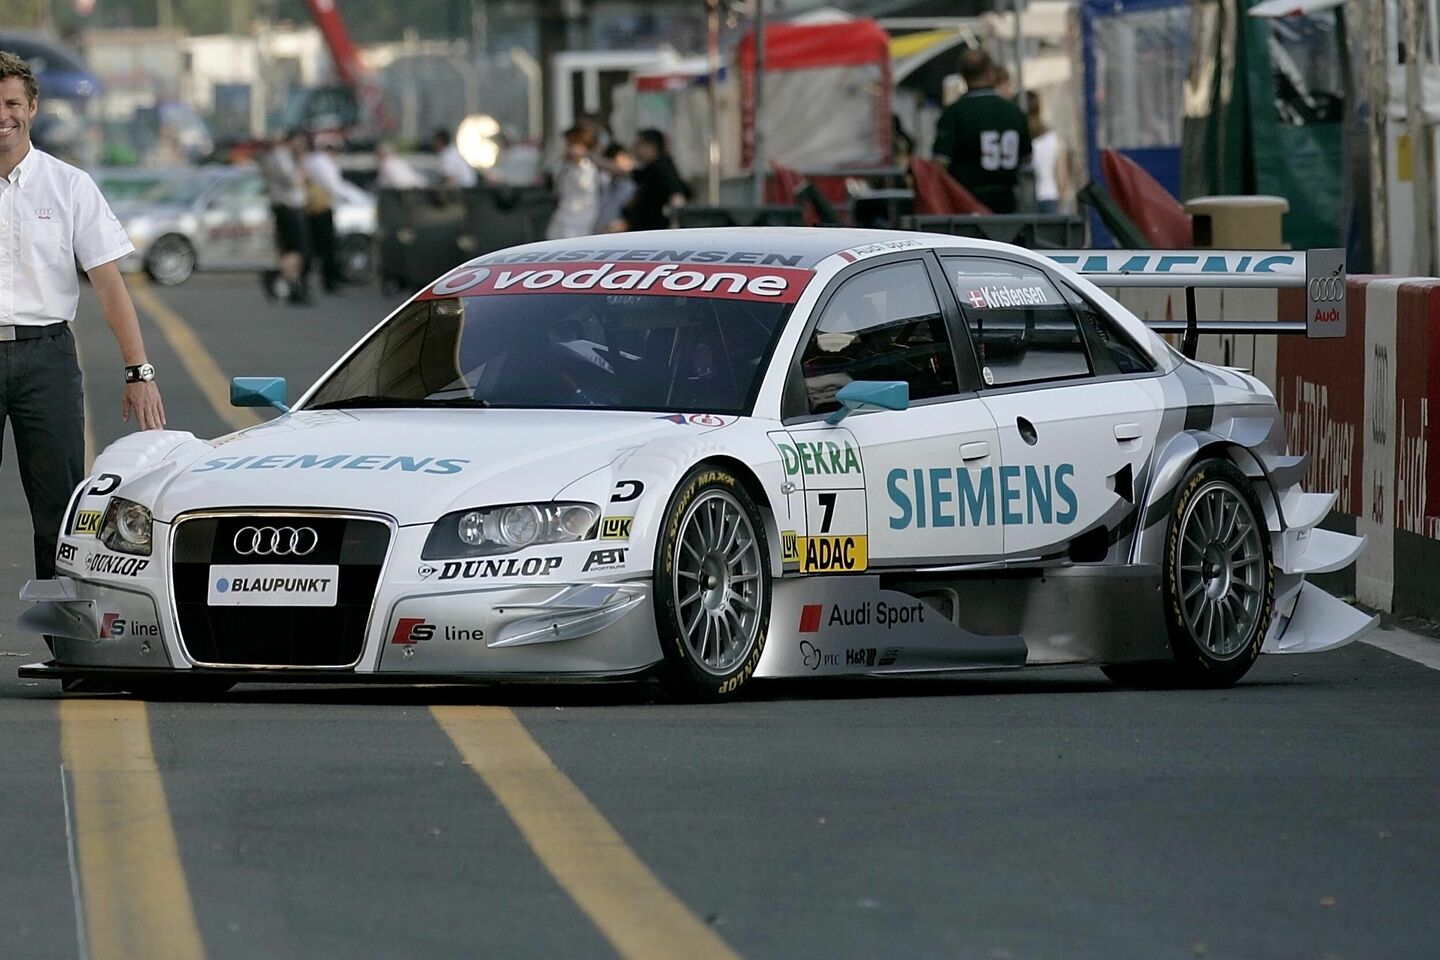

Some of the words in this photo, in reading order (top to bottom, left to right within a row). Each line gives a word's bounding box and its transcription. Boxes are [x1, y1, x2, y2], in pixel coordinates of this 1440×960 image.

[980, 131, 1019, 171] 59
[479, 248, 803, 266] KRISTENSEN
[493, 263, 788, 297] vodafone
[980, 285, 1047, 308] Kristensen
[1314, 308, 1340, 322] Audi
[190, 454, 472, 475] SIEMENS
[778, 440, 861, 476] DEKRA
[1396, 397, 1428, 536] Audi
[886, 464, 1078, 530] SIEMENS
[818, 493, 837, 534] 7
[58, 543, 79, 561] ABT
[582, 548, 629, 572] ABT
[805, 538, 856, 570] ADAC
[90, 553, 150, 577] DUNLOP
[438, 556, 563, 580] DUNLOP
[231, 578, 331, 594] BLAUPUNKT
[828, 602, 871, 627] Audi
[876, 601, 925, 629] Sport
[131, 621, 158, 636] line
[445, 626, 484, 641] line
[718, 630, 765, 694] DUNLOP
